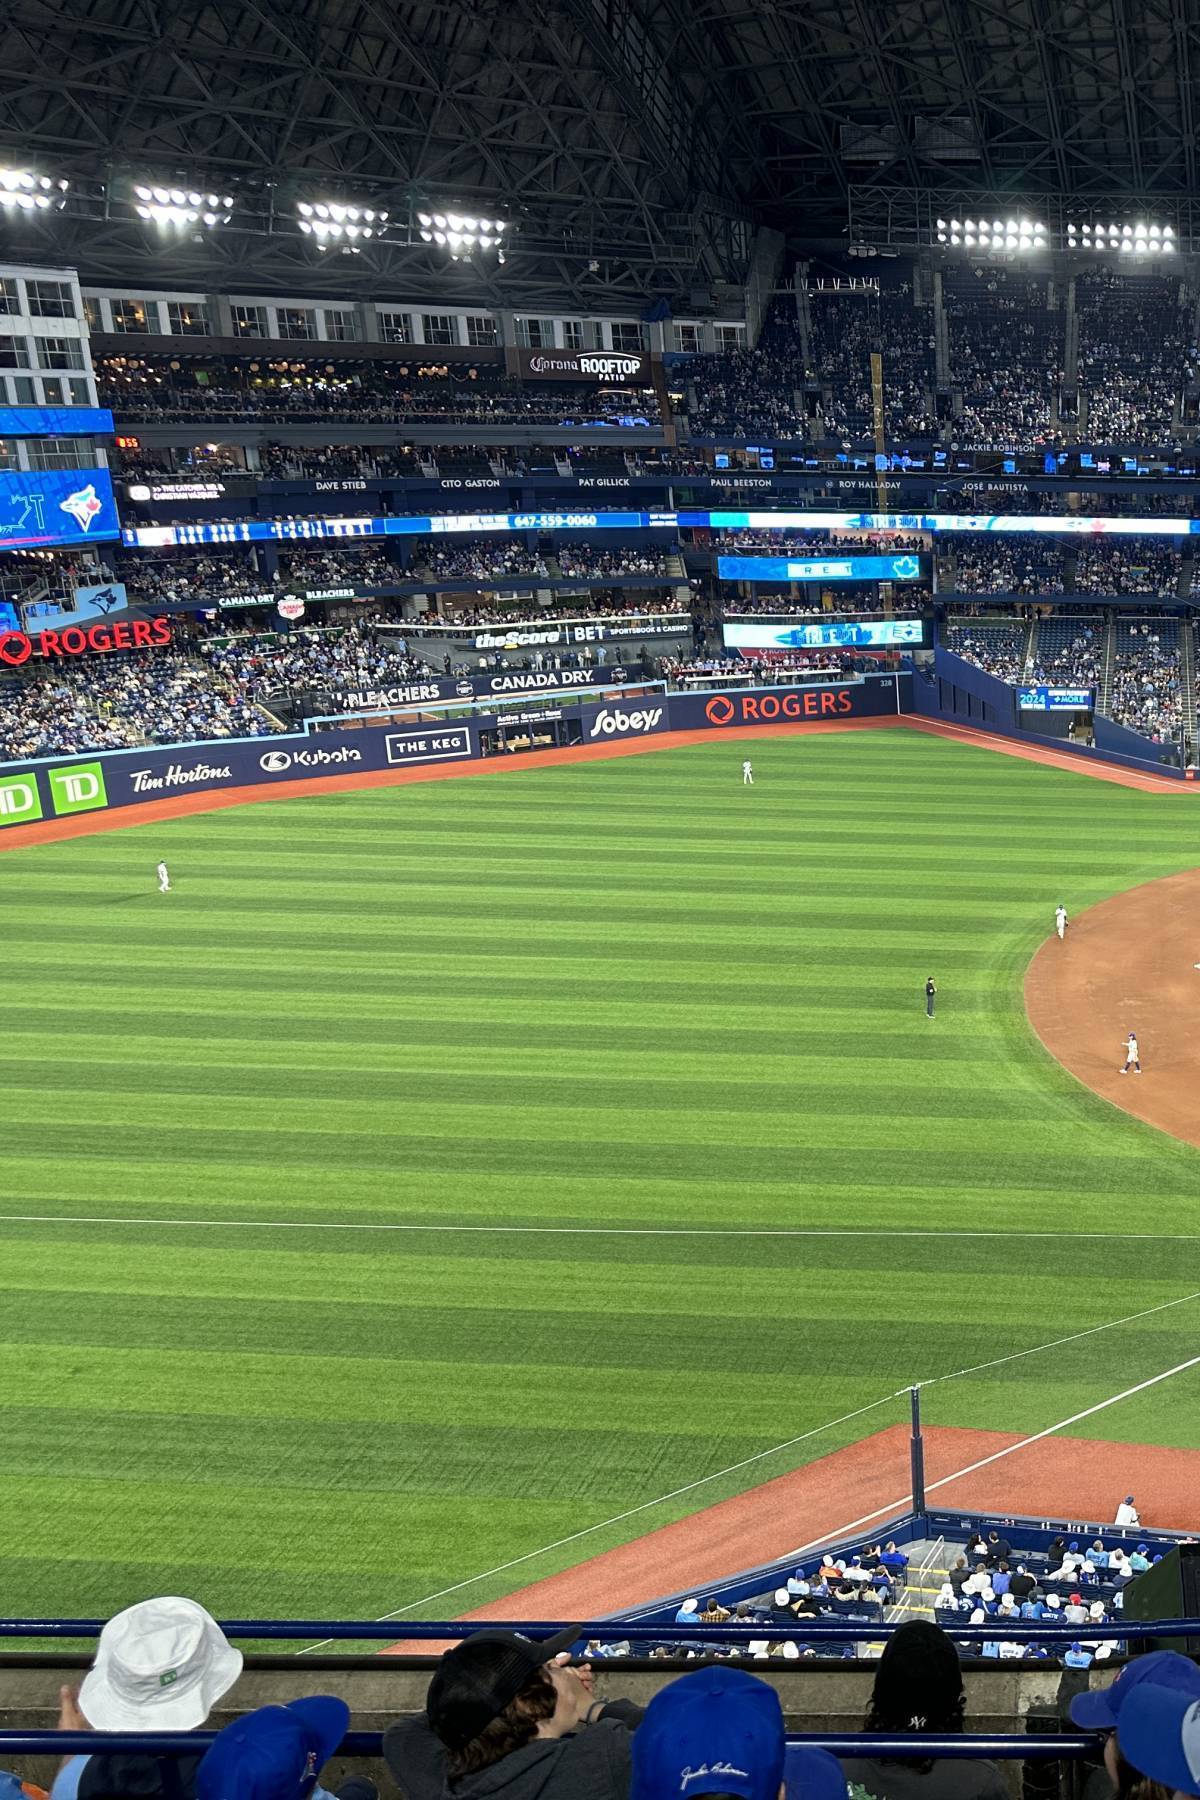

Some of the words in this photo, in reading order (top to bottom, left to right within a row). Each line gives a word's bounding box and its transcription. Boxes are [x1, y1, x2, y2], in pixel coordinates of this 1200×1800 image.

[530, 357, 578, 373] Corona
[580, 358, 641, 374] ROOFTOP
[963, 443, 991, 451] JACKIE
[993, 444, 1035, 452] ROBINSON
[316, 481, 339, 490] DAVE
[342, 481, 366, 490] STIEB
[441, 479, 462, 488] CITO
[465, 479, 500, 488] GASTON
[579, 478, 595, 487] PAT
[596, 478, 630, 487] GILLICK
[710, 479, 732, 487] PAUL
[734, 479, 772, 487] BEESTON
[839, 480, 856, 488] ROY
[858, 481, 901, 489] HALLADAY
[962, 481, 984, 490] JOSÉ
[987, 483, 1028, 492] BAUTISTA
[514, 514, 597, 526] 647-559-0060
[219, 596, 257, 606] CANADA
[258, 594, 275, 602] DRY
[306, 589, 355, 599] BLEACHERS
[40, 618, 173, 658] ROGERS
[475, 631, 560, 648] theScore
[574, 626, 606, 641] BET
[610, 627, 656, 635] SPORTSBOOK
[490, 665, 559, 691] CANADA
[347, 684, 439, 708] BLEACHERS
[1020, 694, 1046, 703] 2024
[741, 690, 853, 720] ROGERS
[497, 714, 519, 723] Active
[590, 707, 663, 737] Sobeys
[397, 740, 427, 753] THE
[432, 736, 462, 751] KEG
[294, 747, 362, 767] Kubota
[55, 772, 99, 803] TD
[129, 770, 166, 793] Tim
